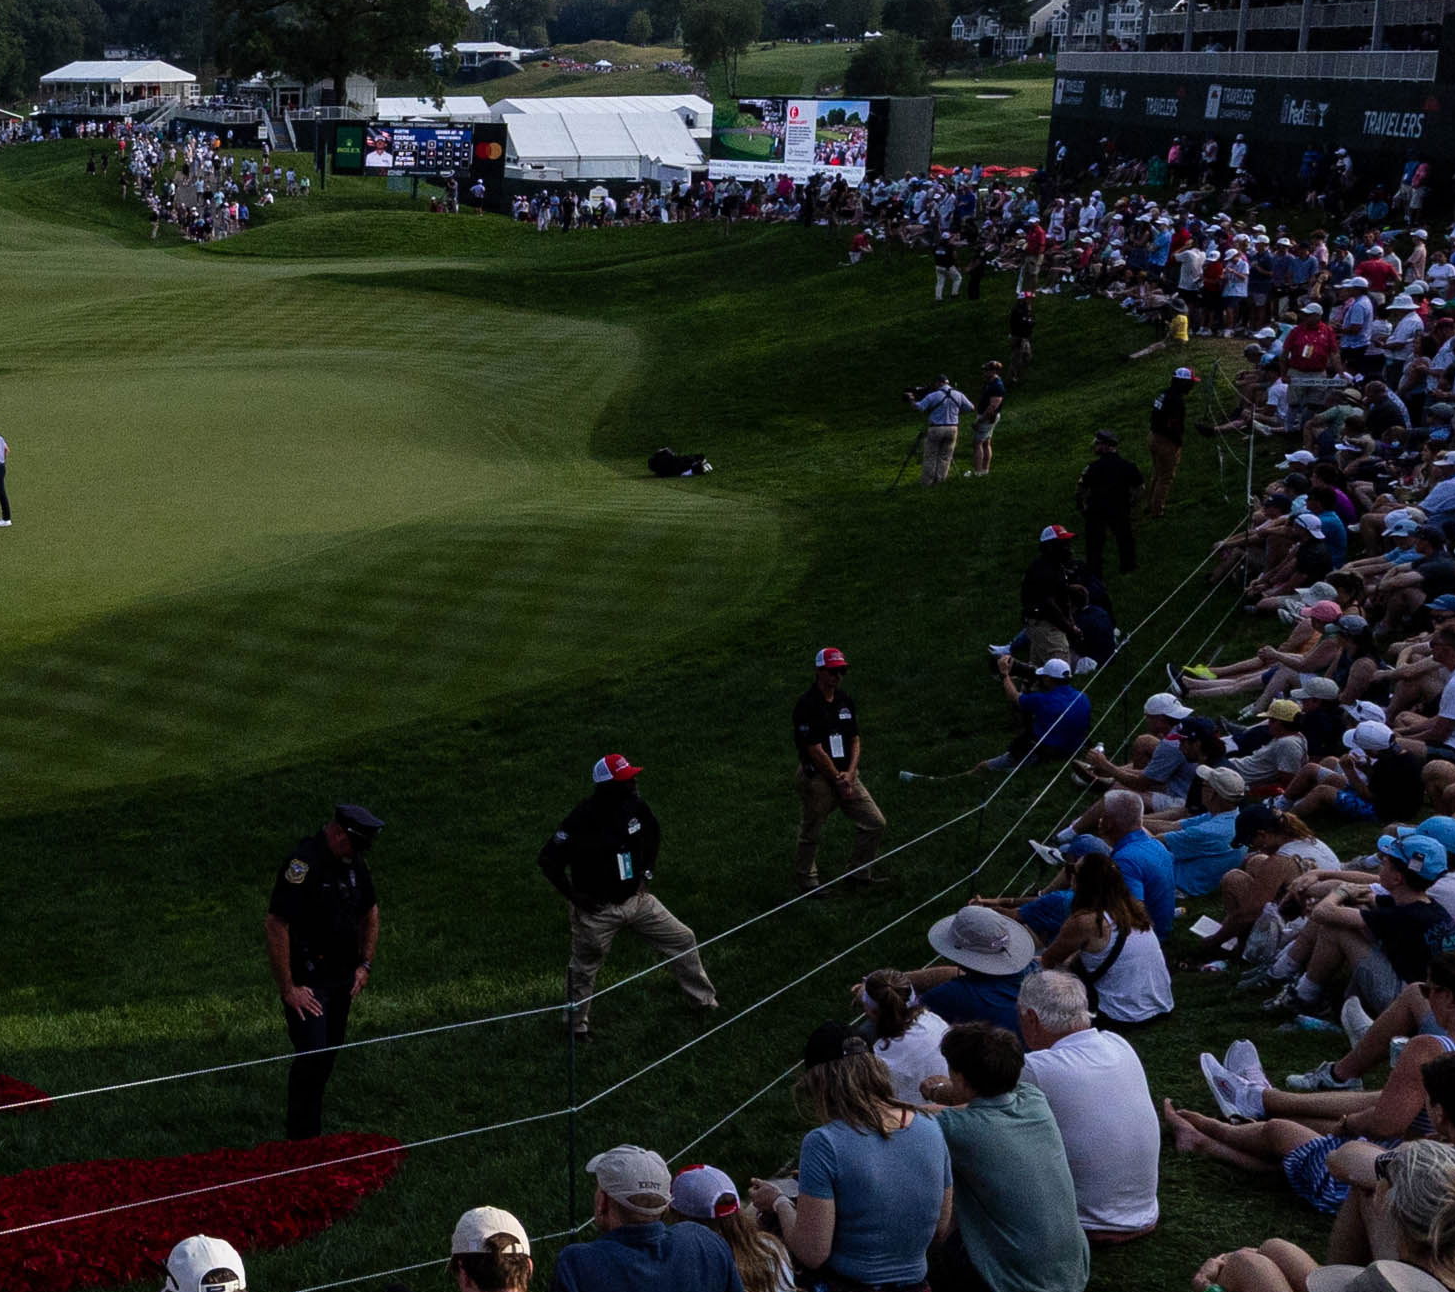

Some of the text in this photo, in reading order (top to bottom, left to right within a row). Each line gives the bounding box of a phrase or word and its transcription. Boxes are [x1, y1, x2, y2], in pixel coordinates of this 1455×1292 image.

[1222, 87, 1257, 106] TRAVELERS
[1145, 97, 1180, 118] TRAVELERS
[1291, 98, 1319, 127] FedEx
[1363, 111, 1425, 139] TRAVELERS
[637, 1181, 661, 1190] KENT
